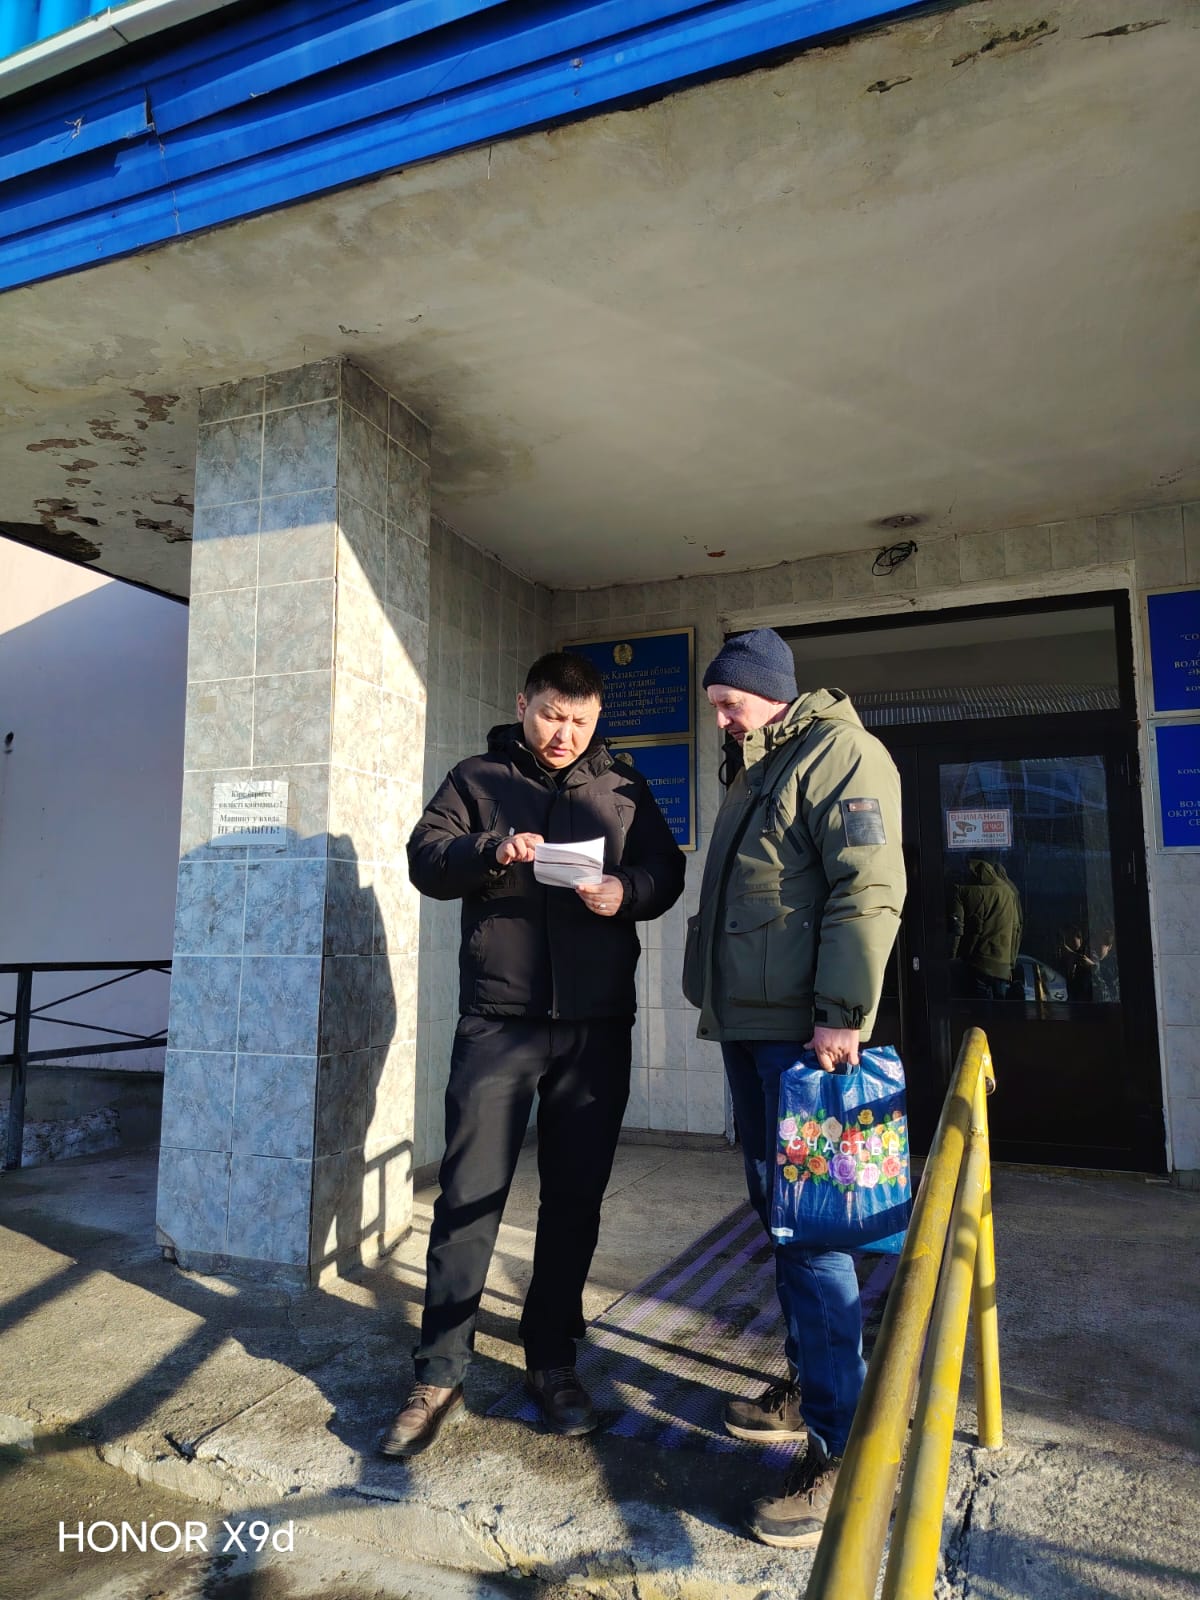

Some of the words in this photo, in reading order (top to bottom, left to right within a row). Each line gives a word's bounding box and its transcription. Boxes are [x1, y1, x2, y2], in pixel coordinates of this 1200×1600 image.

[220, 814, 250, 823] Машину
[951, 813, 1005, 821] ВНИМАНИЕ!
[217, 825, 229, 835] НЕ
[790, 1135, 899, 1156] СЧАСТЬЕ
